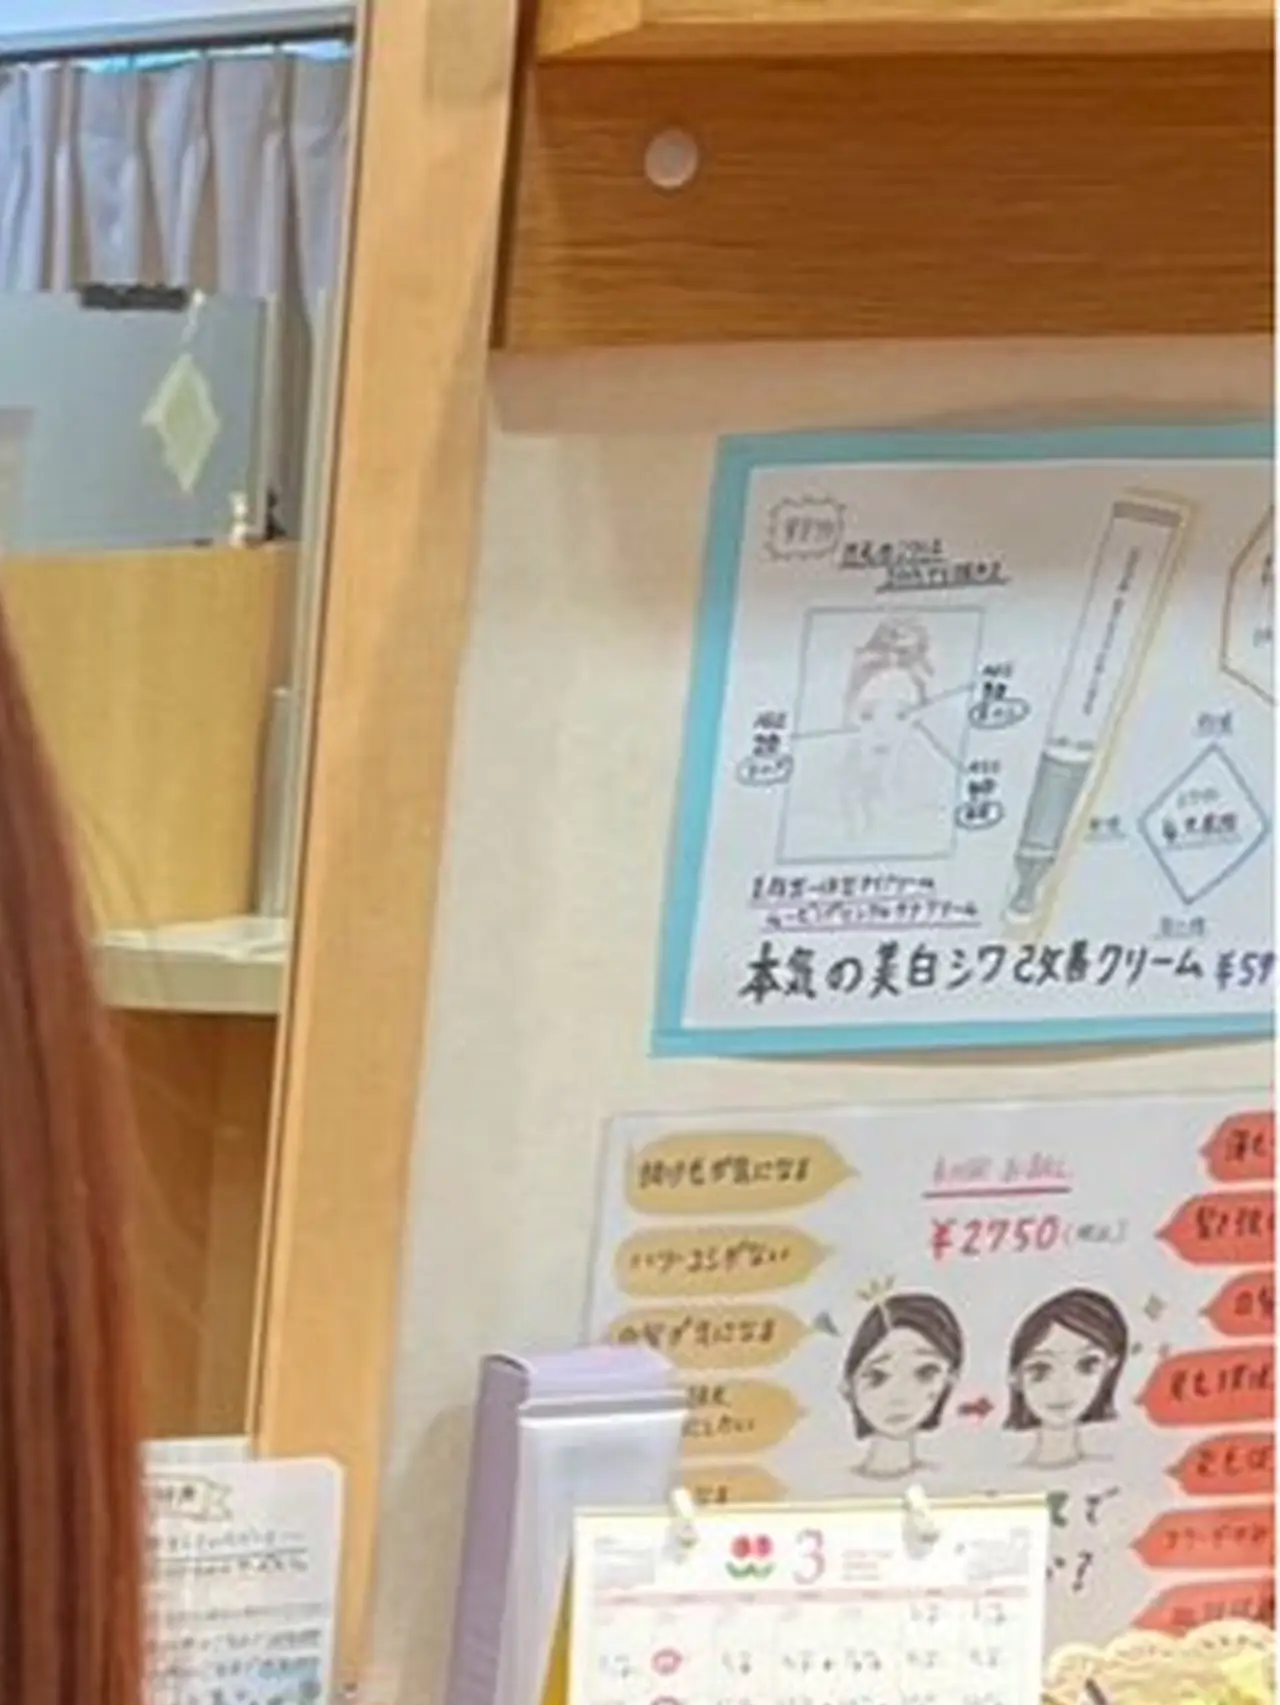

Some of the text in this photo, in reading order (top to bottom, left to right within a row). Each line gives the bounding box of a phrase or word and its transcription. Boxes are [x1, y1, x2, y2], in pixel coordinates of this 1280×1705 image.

[738, 940, 1204, 1004] 本気の美白シワ改善クリーム
[930, 1212, 1062, 1261] ¥2750
[792, 1528, 827, 1586] 3
